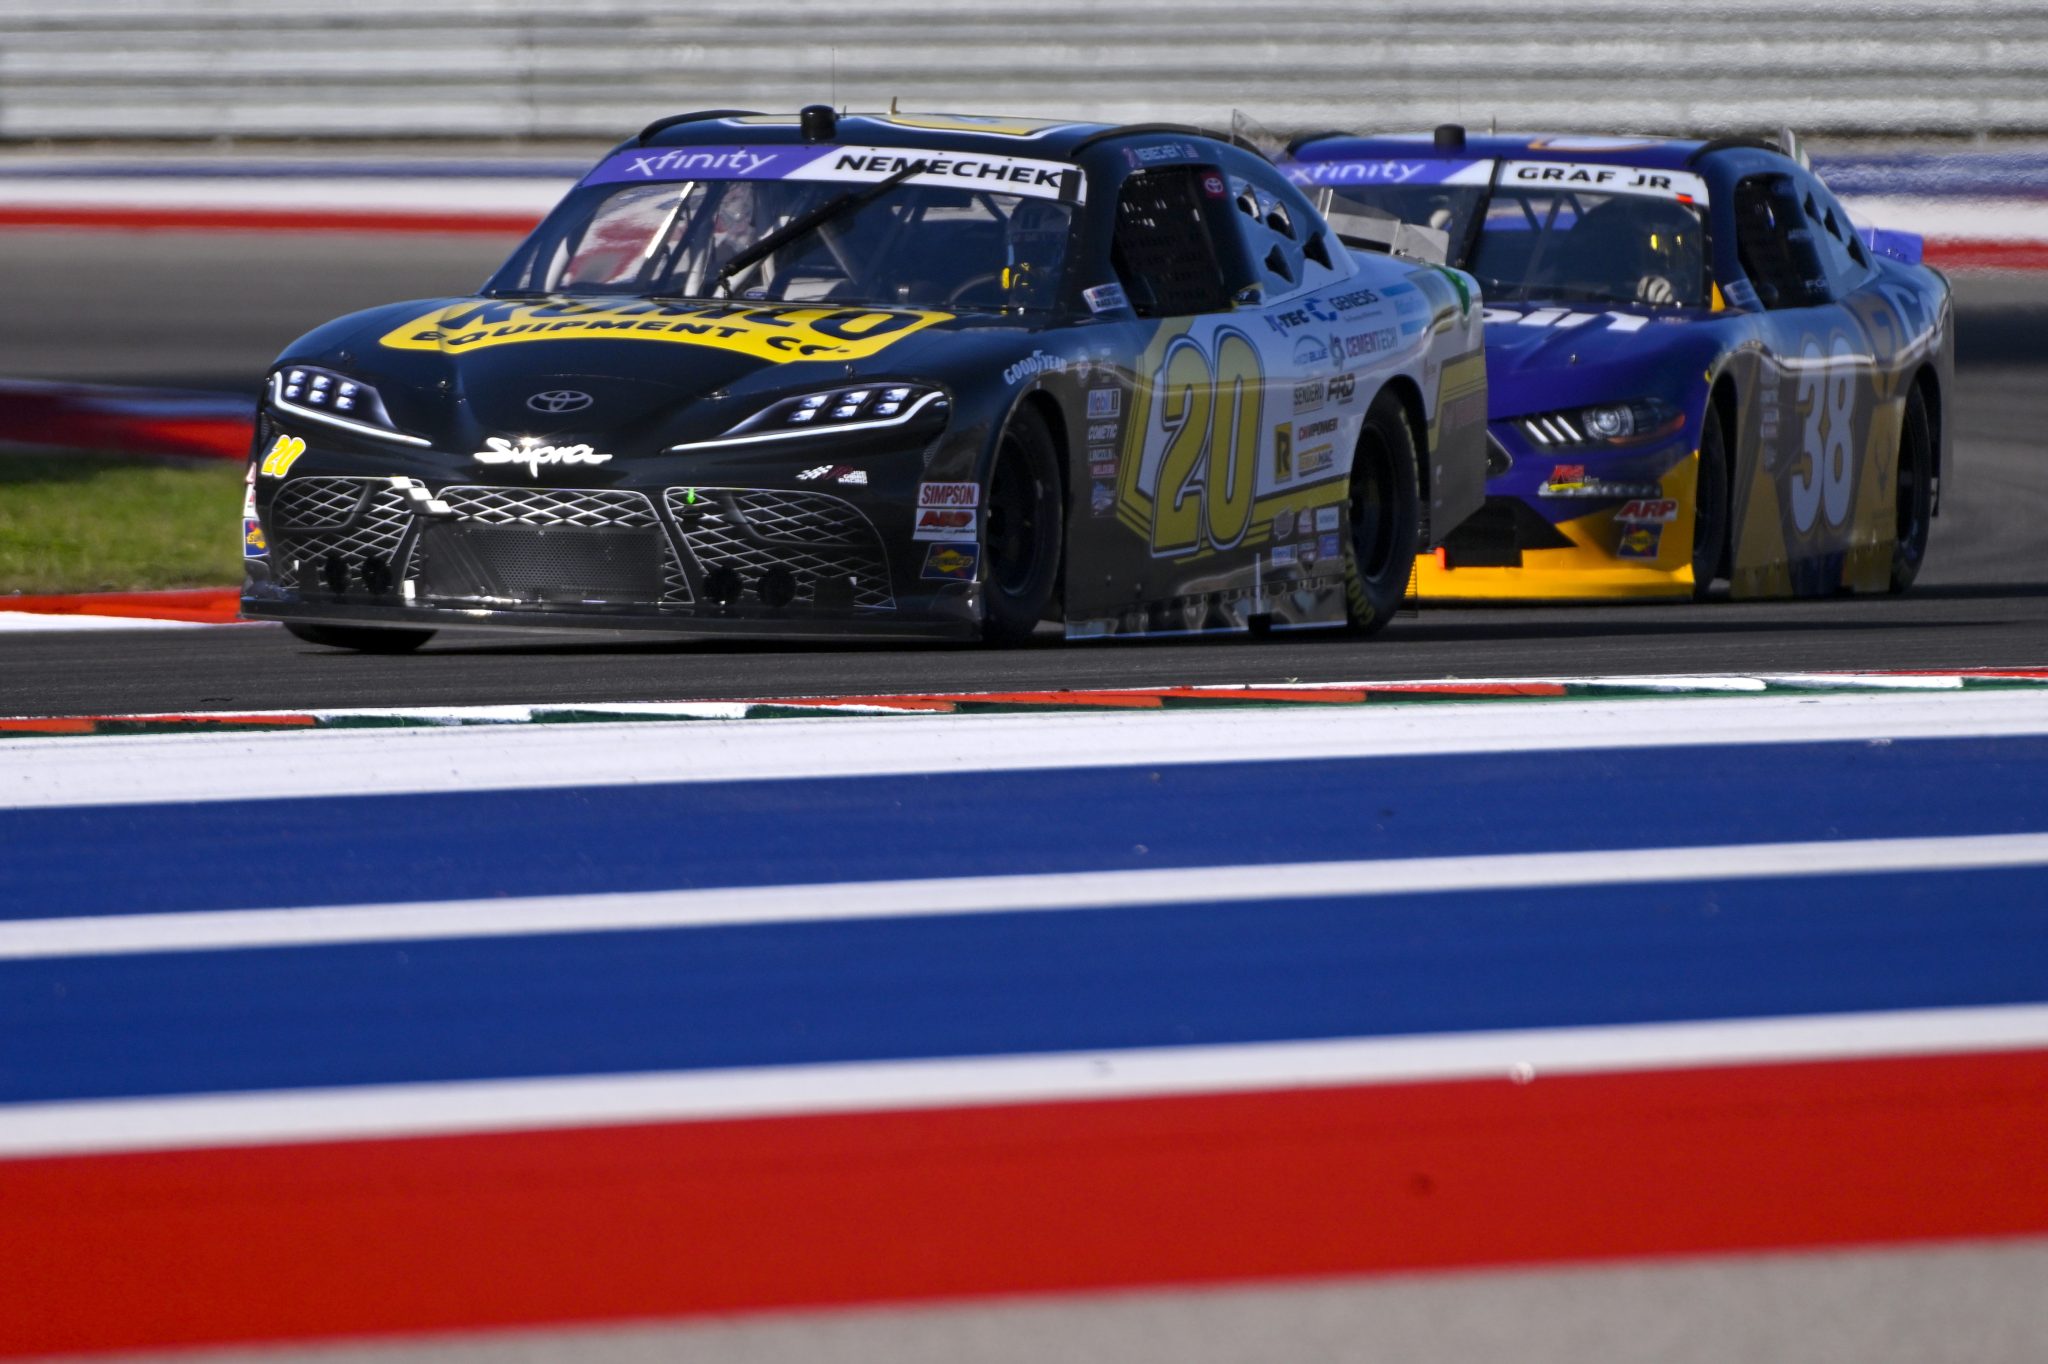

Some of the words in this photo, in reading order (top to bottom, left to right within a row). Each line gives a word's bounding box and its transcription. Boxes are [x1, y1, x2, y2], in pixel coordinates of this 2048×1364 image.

[624, 148, 777, 178] xfinity
[1288, 160, 1426, 185] xfinity
[1517, 166, 1616, 184] GRAF
[1628, 174, 1672, 190] JR
[411, 320, 749, 345] EQUIPMENT
[1003, 350, 1067, 385] GOODYEAR
[1151, 326, 1266, 559] 20
[1791, 336, 1857, 533] 38
[261, 434, 307, 479] 20
[473, 436, 613, 479] Supra
[922, 484, 976, 505] SIMPSON
[918, 510, 974, 528] ARP
[1619, 499, 1678, 518] ARP
